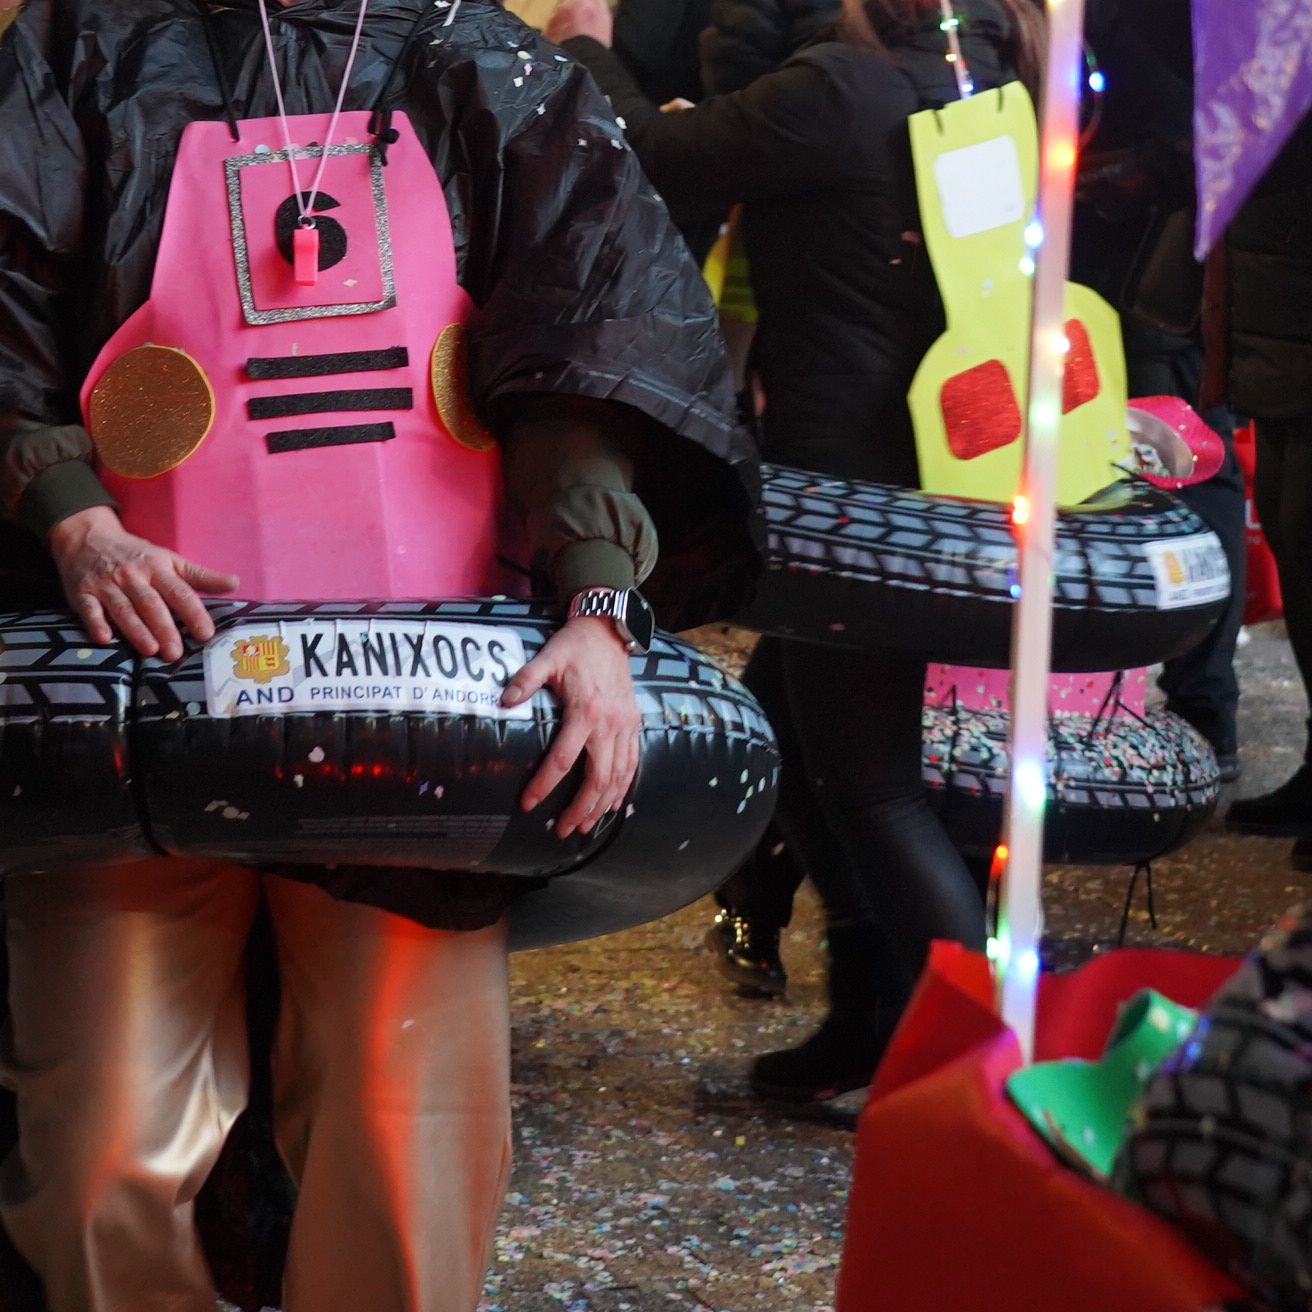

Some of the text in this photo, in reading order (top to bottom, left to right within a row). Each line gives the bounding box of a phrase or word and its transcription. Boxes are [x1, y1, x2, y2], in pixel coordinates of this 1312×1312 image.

[274, 190, 348, 273] 6
[300, 631, 510, 687] KANIXOCS
[237, 684, 295, 706] AND
[310, 684, 403, 702] PRINCIPAT
